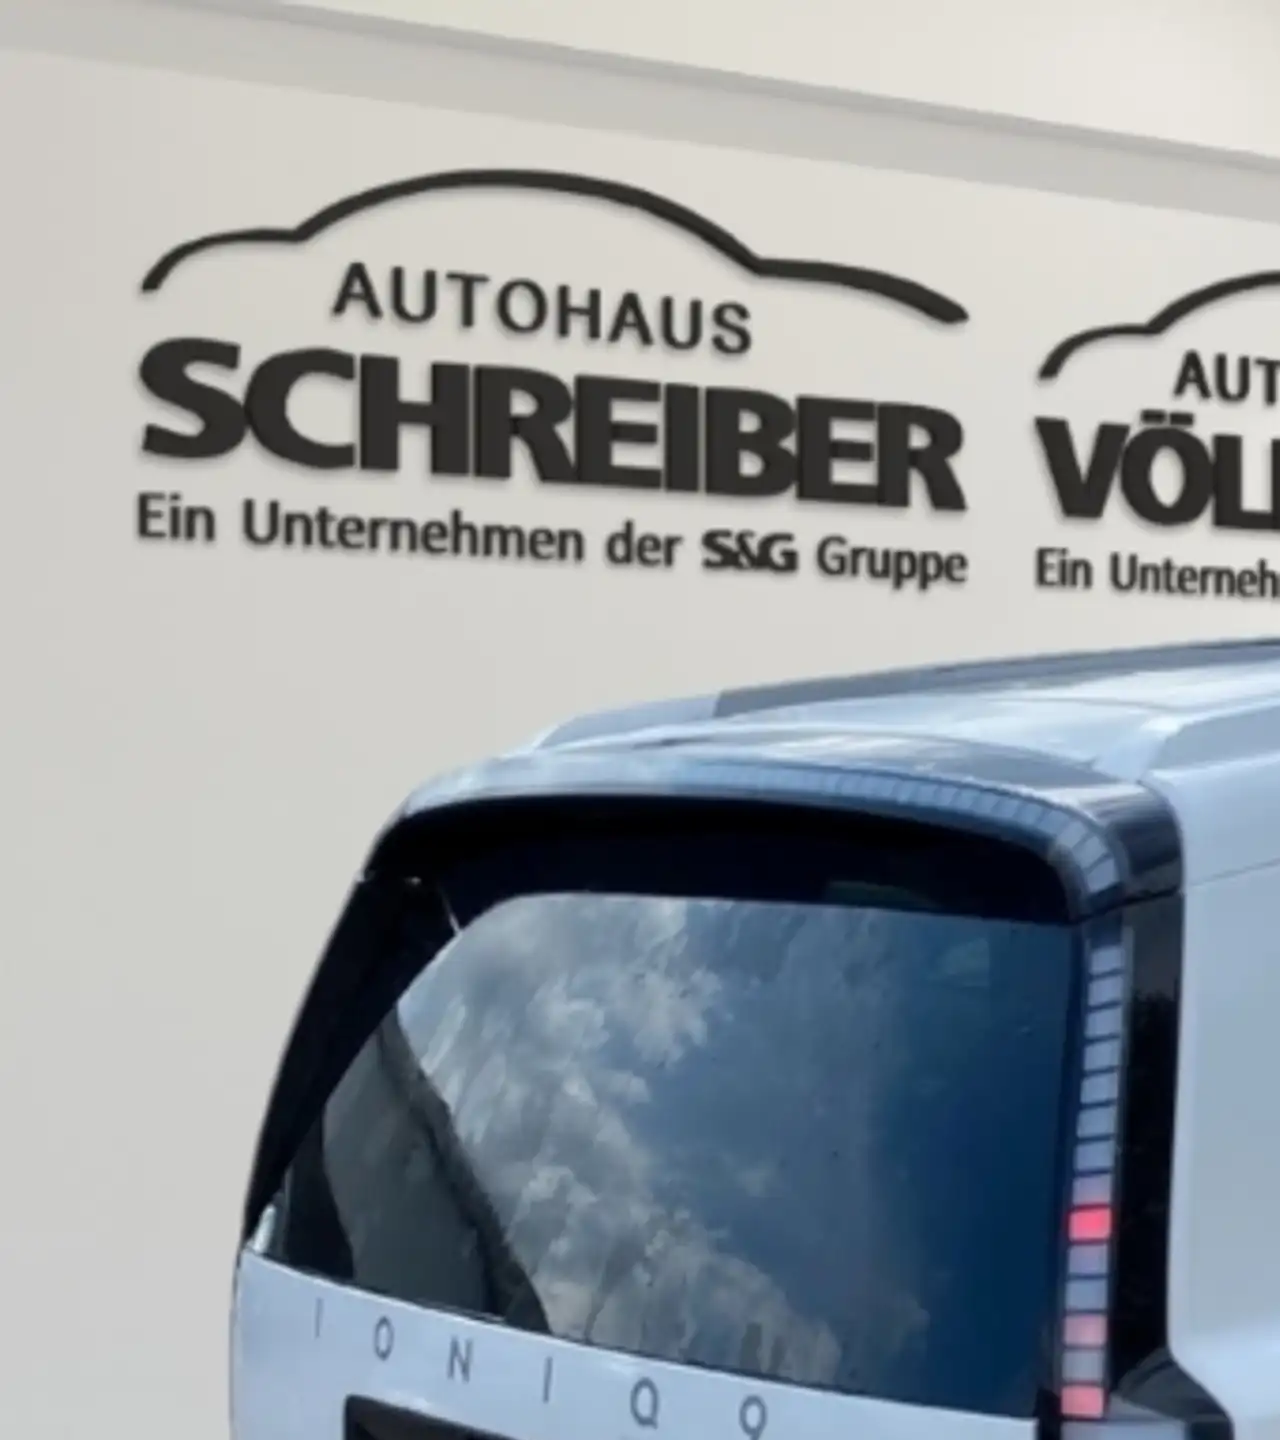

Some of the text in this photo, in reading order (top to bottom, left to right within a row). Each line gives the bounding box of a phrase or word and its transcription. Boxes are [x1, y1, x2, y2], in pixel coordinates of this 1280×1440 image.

[332, 261, 753, 356] AUTOHAUS
[138, 336, 968, 513] SCHREIBER
[137, 491, 969, 592] Ein Unternehmen der S&G Gruppe
[1035, 546, 1093, 592] Ein
